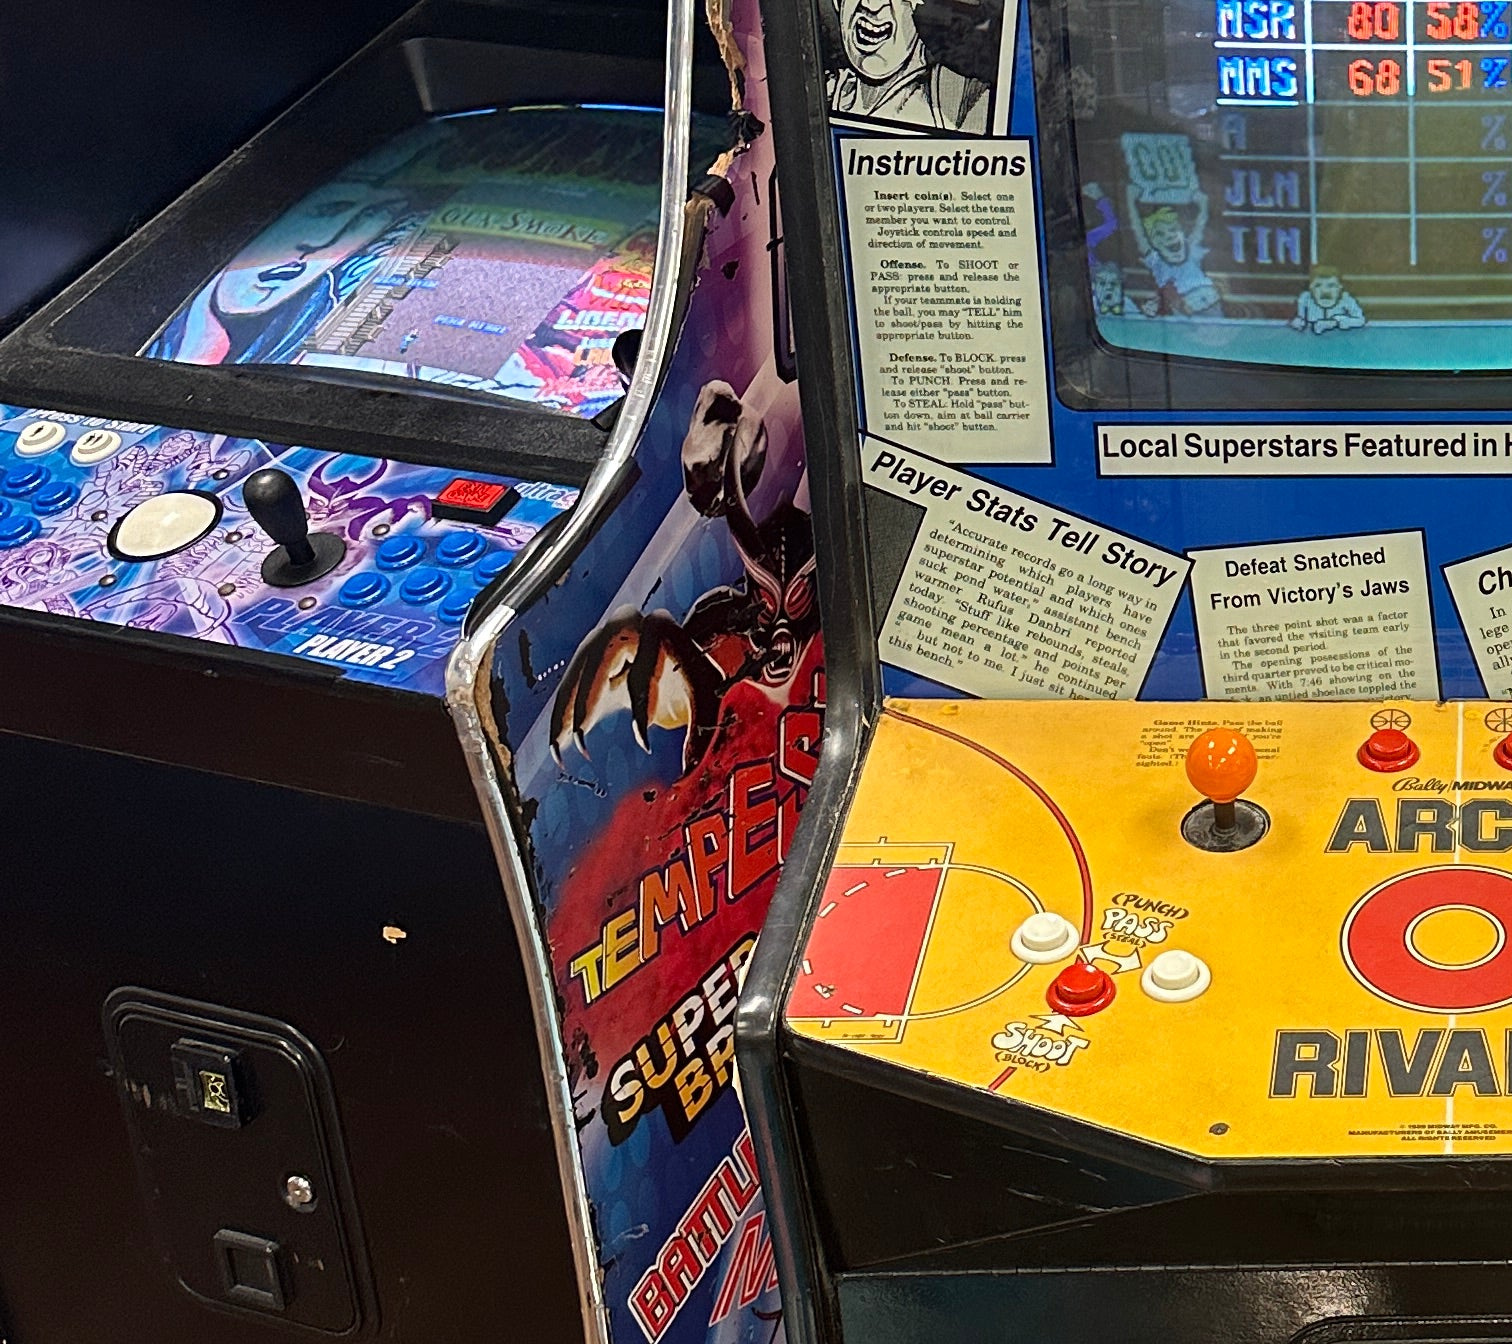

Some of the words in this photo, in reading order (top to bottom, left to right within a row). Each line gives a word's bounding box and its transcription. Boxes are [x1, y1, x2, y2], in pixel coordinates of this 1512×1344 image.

[1348, 1, 1399, 40] 80
[1349, 59, 1401, 96] 68
[848, 149, 1026, 176] Instructions
[1103, 433, 1177, 459] Local
[1184, 433, 1338, 464] Superstars
[1344, 432, 1466, 458] Featured
[1473, 432, 1497, 457] in
[870, 450, 963, 502] Player
[966, 487, 1038, 533] Stats
[1047, 517, 1100, 556] Tell
[1101, 541, 1178, 589] Story
[1225, 556, 1287, 579] Defeat
[1294, 547, 1386, 572] Snatched
[1210, 590, 1261, 611] From
[1267, 581, 1354, 610] Victory's
[1360, 577, 1410, 599] Jaws
[1490, 606, 1507, 620] In
[293, 634, 389, 667] PLAYER
[381, 649, 416, 670] 2
[1391, 776, 1449, 795] Bally
[570, 701, 825, 1006] TEMPES
[1111, 892, 1190, 920] (PUNCH)
[1101, 907, 1175, 944] PASS
[991, 1021, 1091, 1067] SHOOT
[995, 1051, 1051, 1073] (BLOCK)
